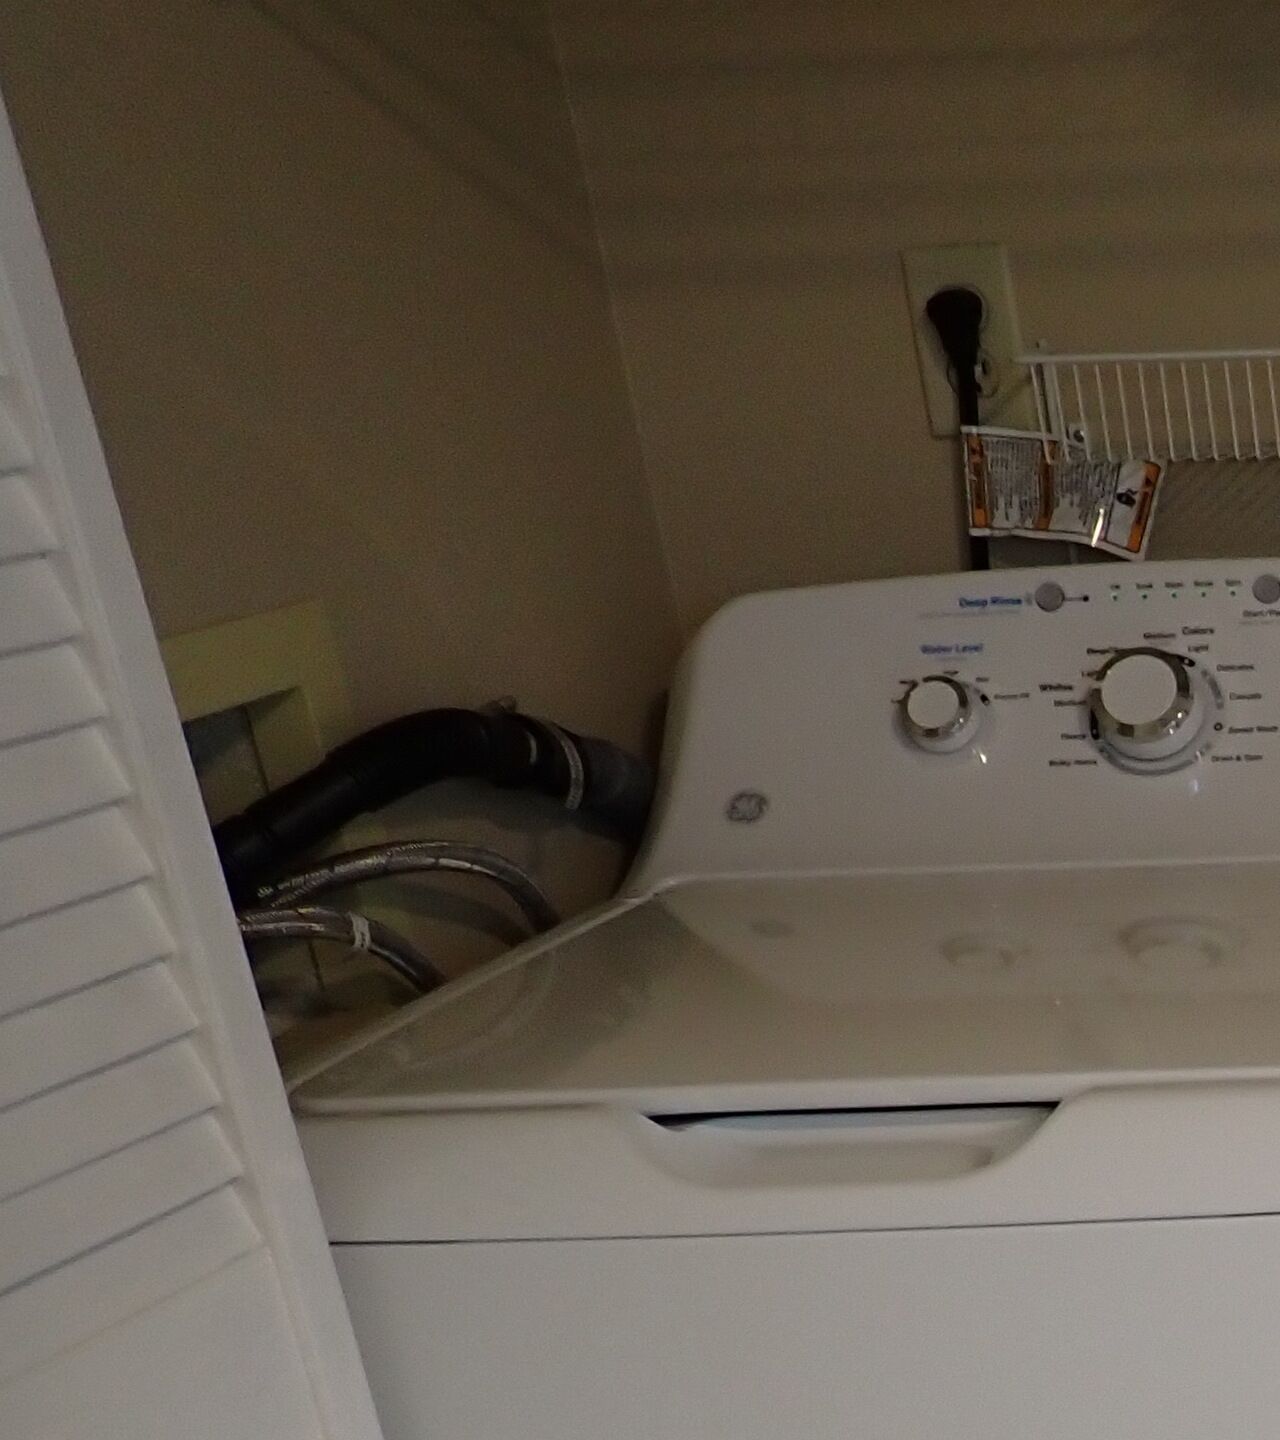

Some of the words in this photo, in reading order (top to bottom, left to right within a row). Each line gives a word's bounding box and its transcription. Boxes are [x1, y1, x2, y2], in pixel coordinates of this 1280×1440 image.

[959, 597, 988, 608] Deep
[990, 596, 1022, 606] Rinse
[920, 644, 953, 654] Water
[954, 643, 984, 653] Level
